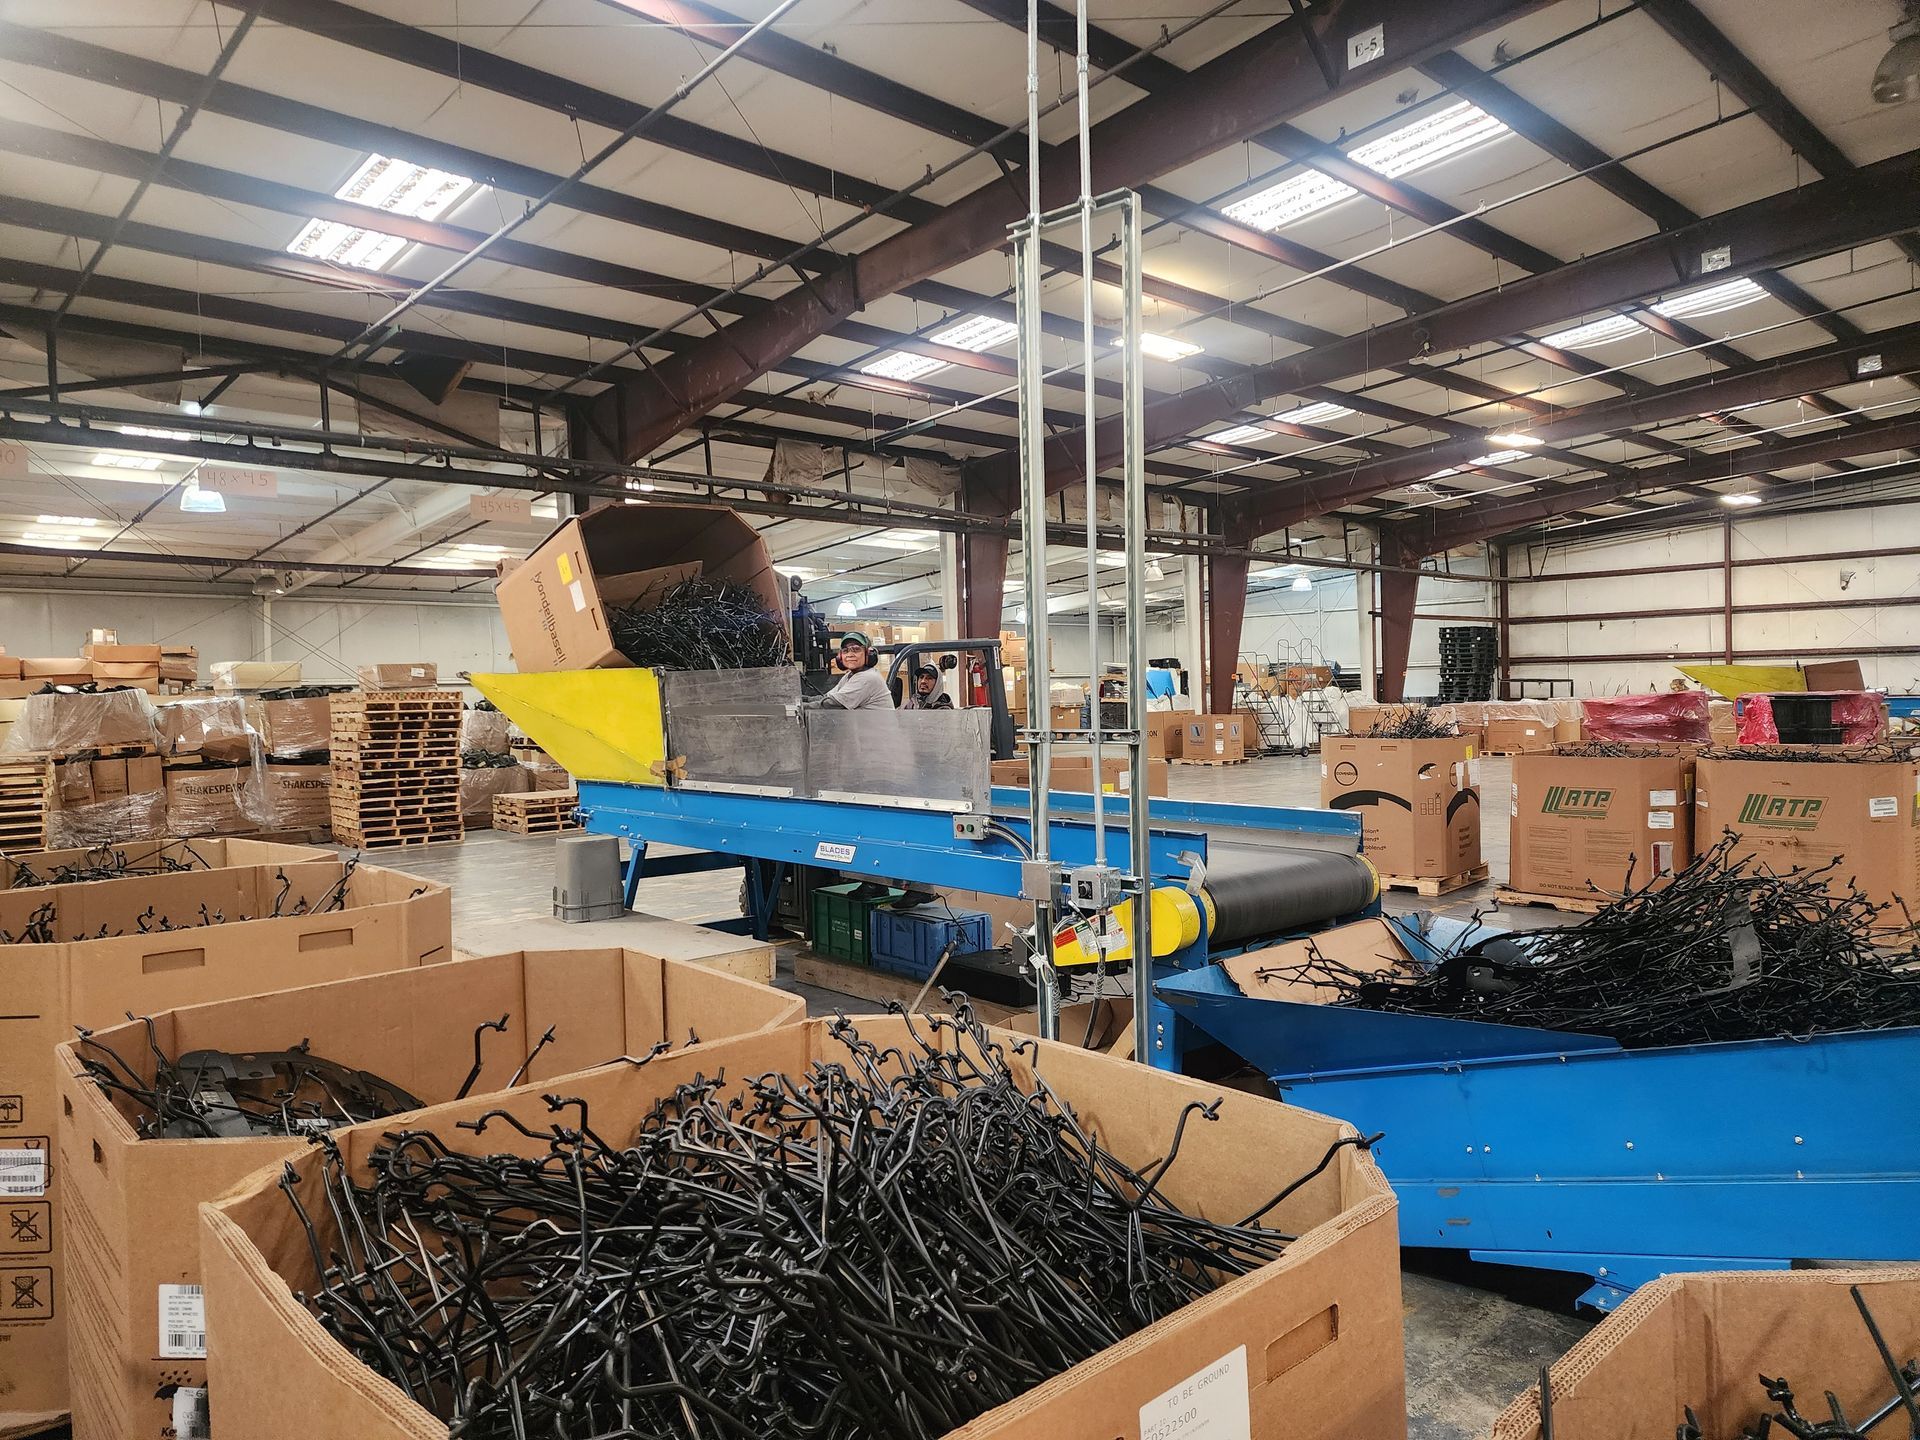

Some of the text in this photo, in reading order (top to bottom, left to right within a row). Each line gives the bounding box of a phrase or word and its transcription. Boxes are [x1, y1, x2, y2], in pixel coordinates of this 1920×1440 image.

[1355, 36, 1377, 58] E-5
[0, 449, 16, 465] 0
[1564, 790, 1611, 807] RTP
[1767, 798, 1822, 817] RTP
[820, 845, 851, 855] BLADES
[1168, 1363, 1230, 1409] TO BE GROUND
[161, 1427, 177, 1438] Ke
